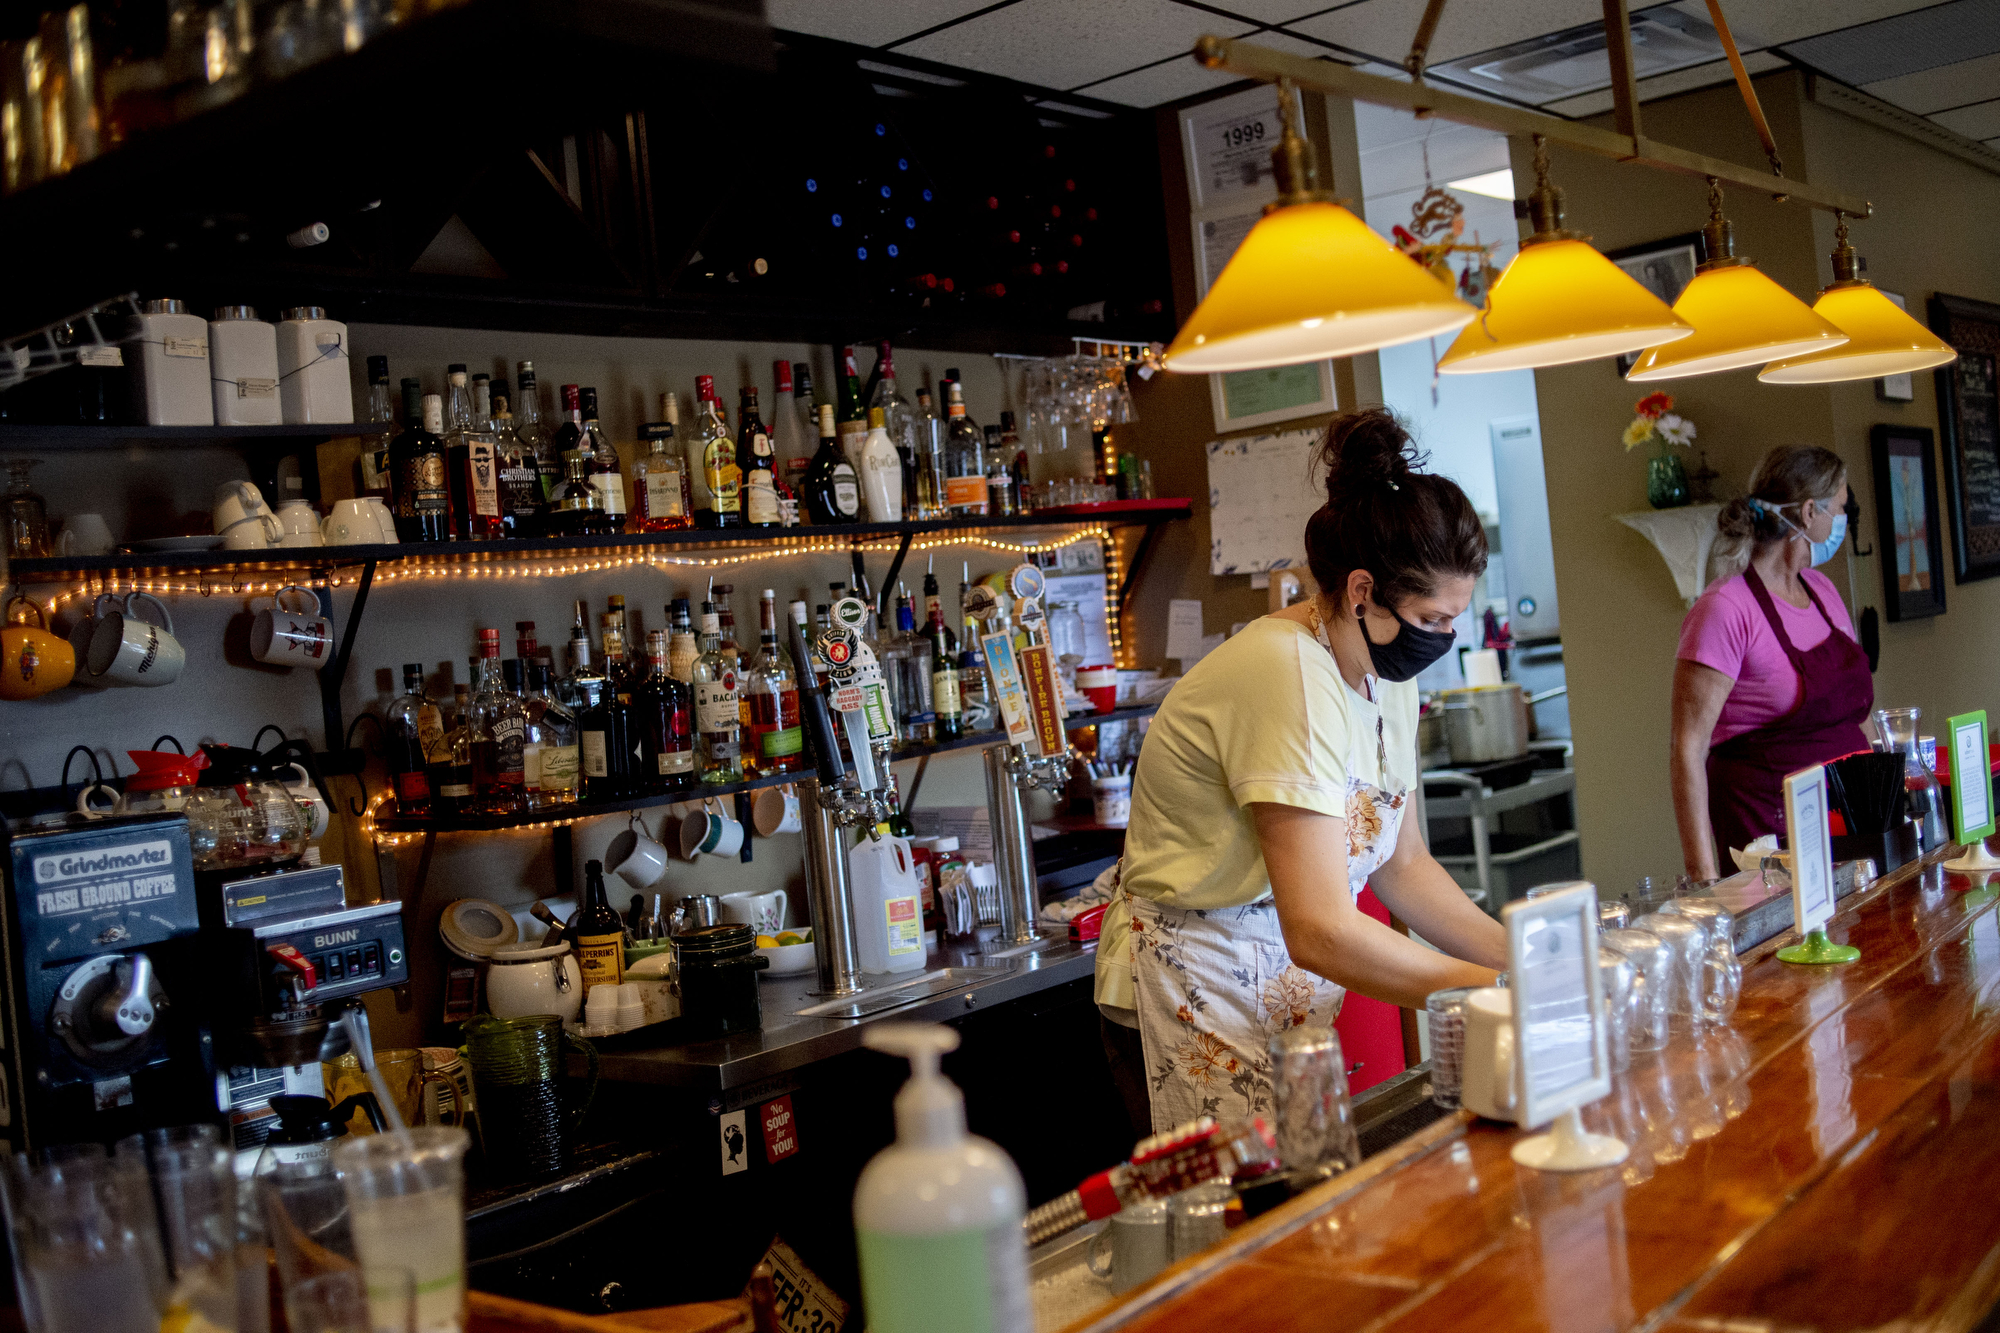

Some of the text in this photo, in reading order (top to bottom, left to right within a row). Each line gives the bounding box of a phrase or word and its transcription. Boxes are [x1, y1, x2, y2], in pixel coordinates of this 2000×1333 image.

[1222, 121, 1265, 147] 1999
[500, 468, 535, 476] CHRISTIAN
[502, 474, 536, 482] BROTHERS
[138, 626, 159, 674] Michigan
[994, 645, 1018, 712] BLONDE
[836, 693, 863, 704] RAGGADY
[838, 687, 861, 697] NORM'S
[841, 702, 860, 711] ASS
[1031, 652, 1048, 708] BONFIRE
[1041, 709, 1056, 751] BROWN
[491, 718, 512, 735] BEER
[868, 705, 887, 734] BROWN
[59, 848, 167, 876] Grindmaster
[37, 873, 176, 915] FRESH GROUND COFFEE
[149, 914, 176, 930] ESPRESSO
[314, 930, 358, 948] BUNN
[770, 1103, 783, 1116] No
[766, 1111, 791, 1132] SOUP
[775, 1128, 786, 1142] for
[772, 1136, 794, 1156] YOU!
[799, 1277, 813, 1294] IT'S
